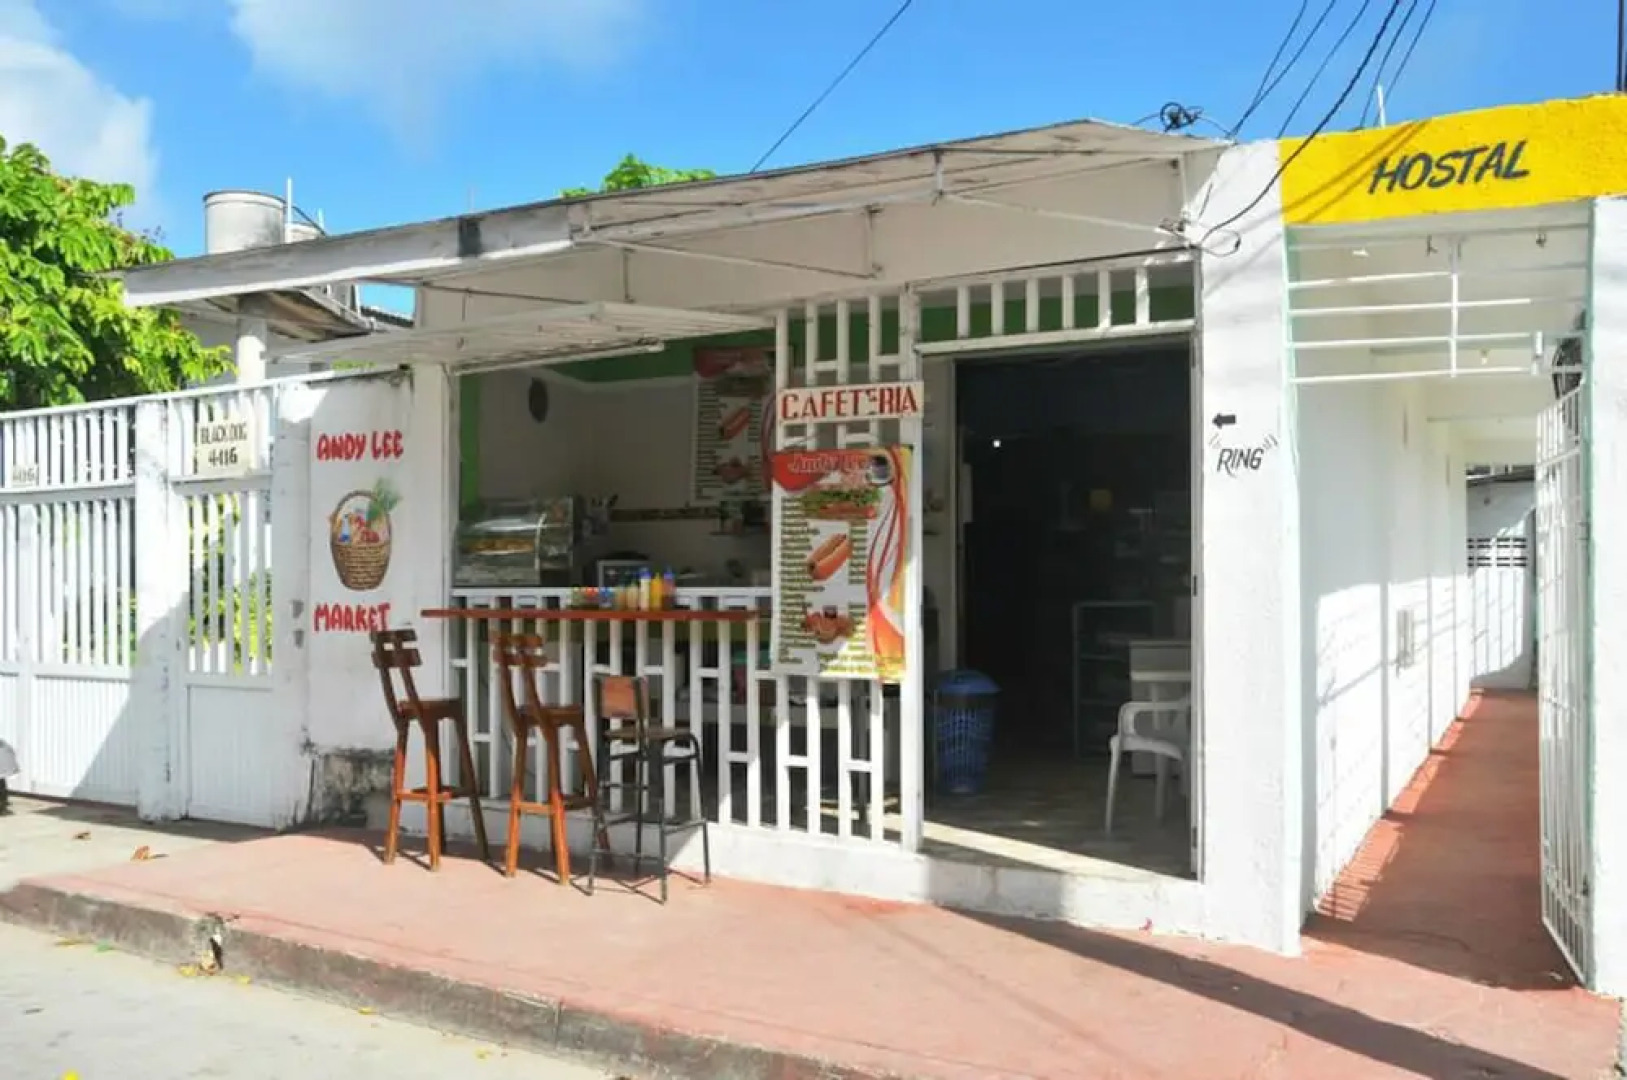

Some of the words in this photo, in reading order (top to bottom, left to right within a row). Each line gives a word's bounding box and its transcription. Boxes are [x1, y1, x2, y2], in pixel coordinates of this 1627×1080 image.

[1367, 139, 1530, 195] HOSTAL
[316, 432, 366, 461] ANDY
[371, 429, 404, 459] LEE
[1216, 447, 1265, 479] RING
[313, 602, 391, 632] MARKET
